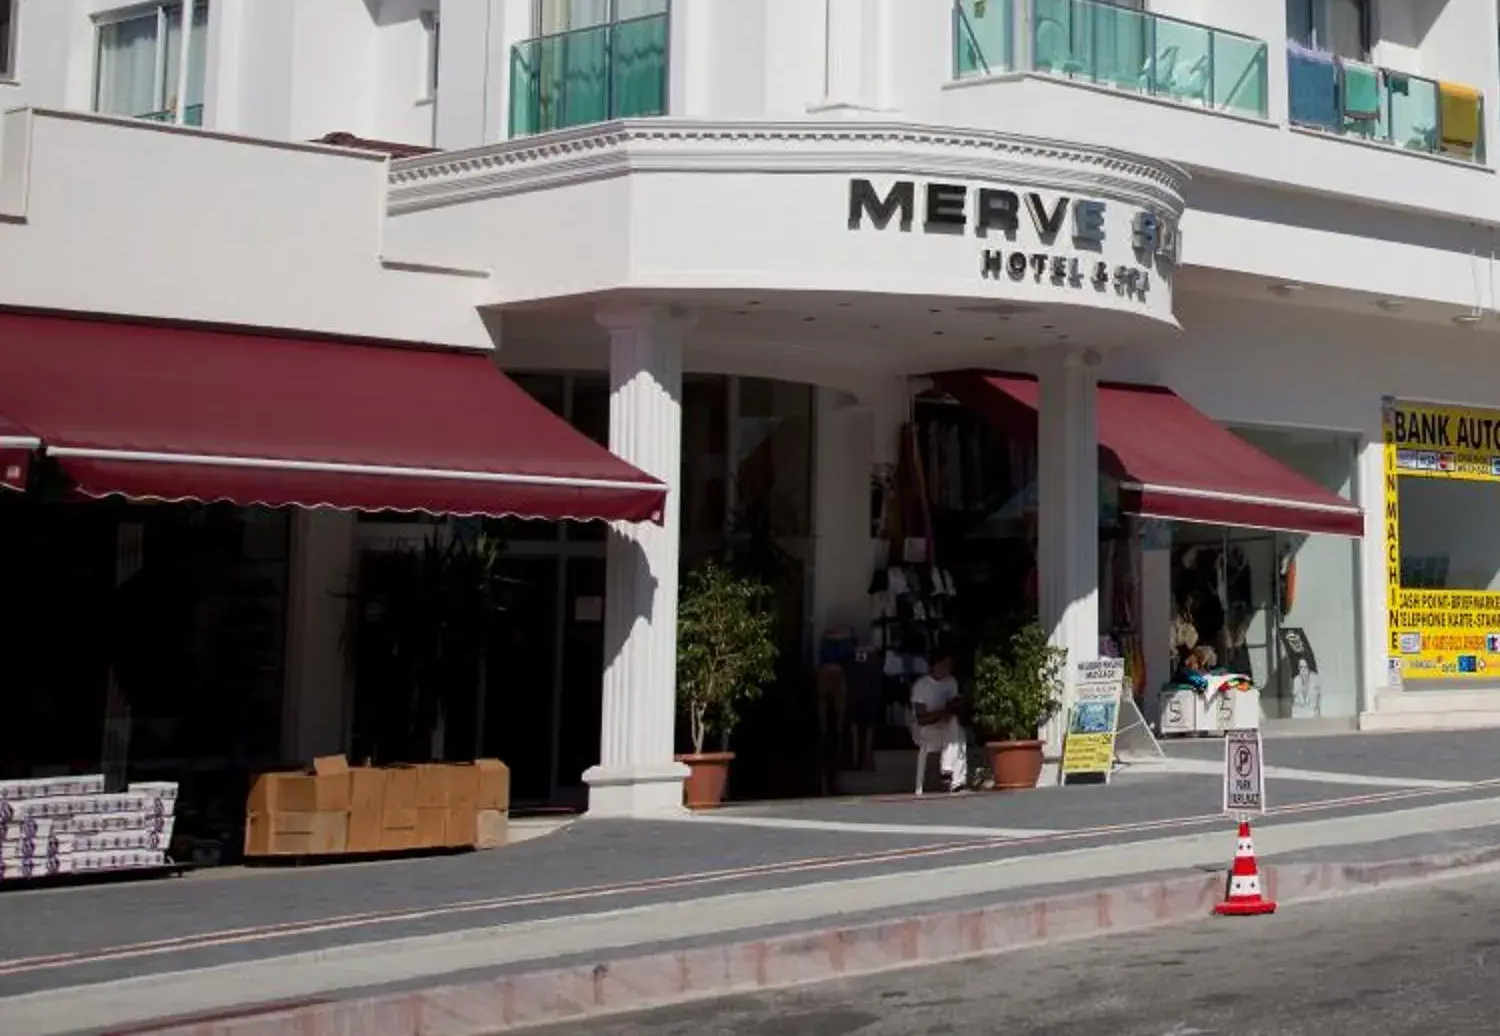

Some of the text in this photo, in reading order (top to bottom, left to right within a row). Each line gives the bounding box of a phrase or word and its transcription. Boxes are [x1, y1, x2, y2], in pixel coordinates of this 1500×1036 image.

[847, 178, 1106, 253] MERVE
[981, 249, 1084, 289] HOTEL
[1395, 411, 1450, 447] BANK
